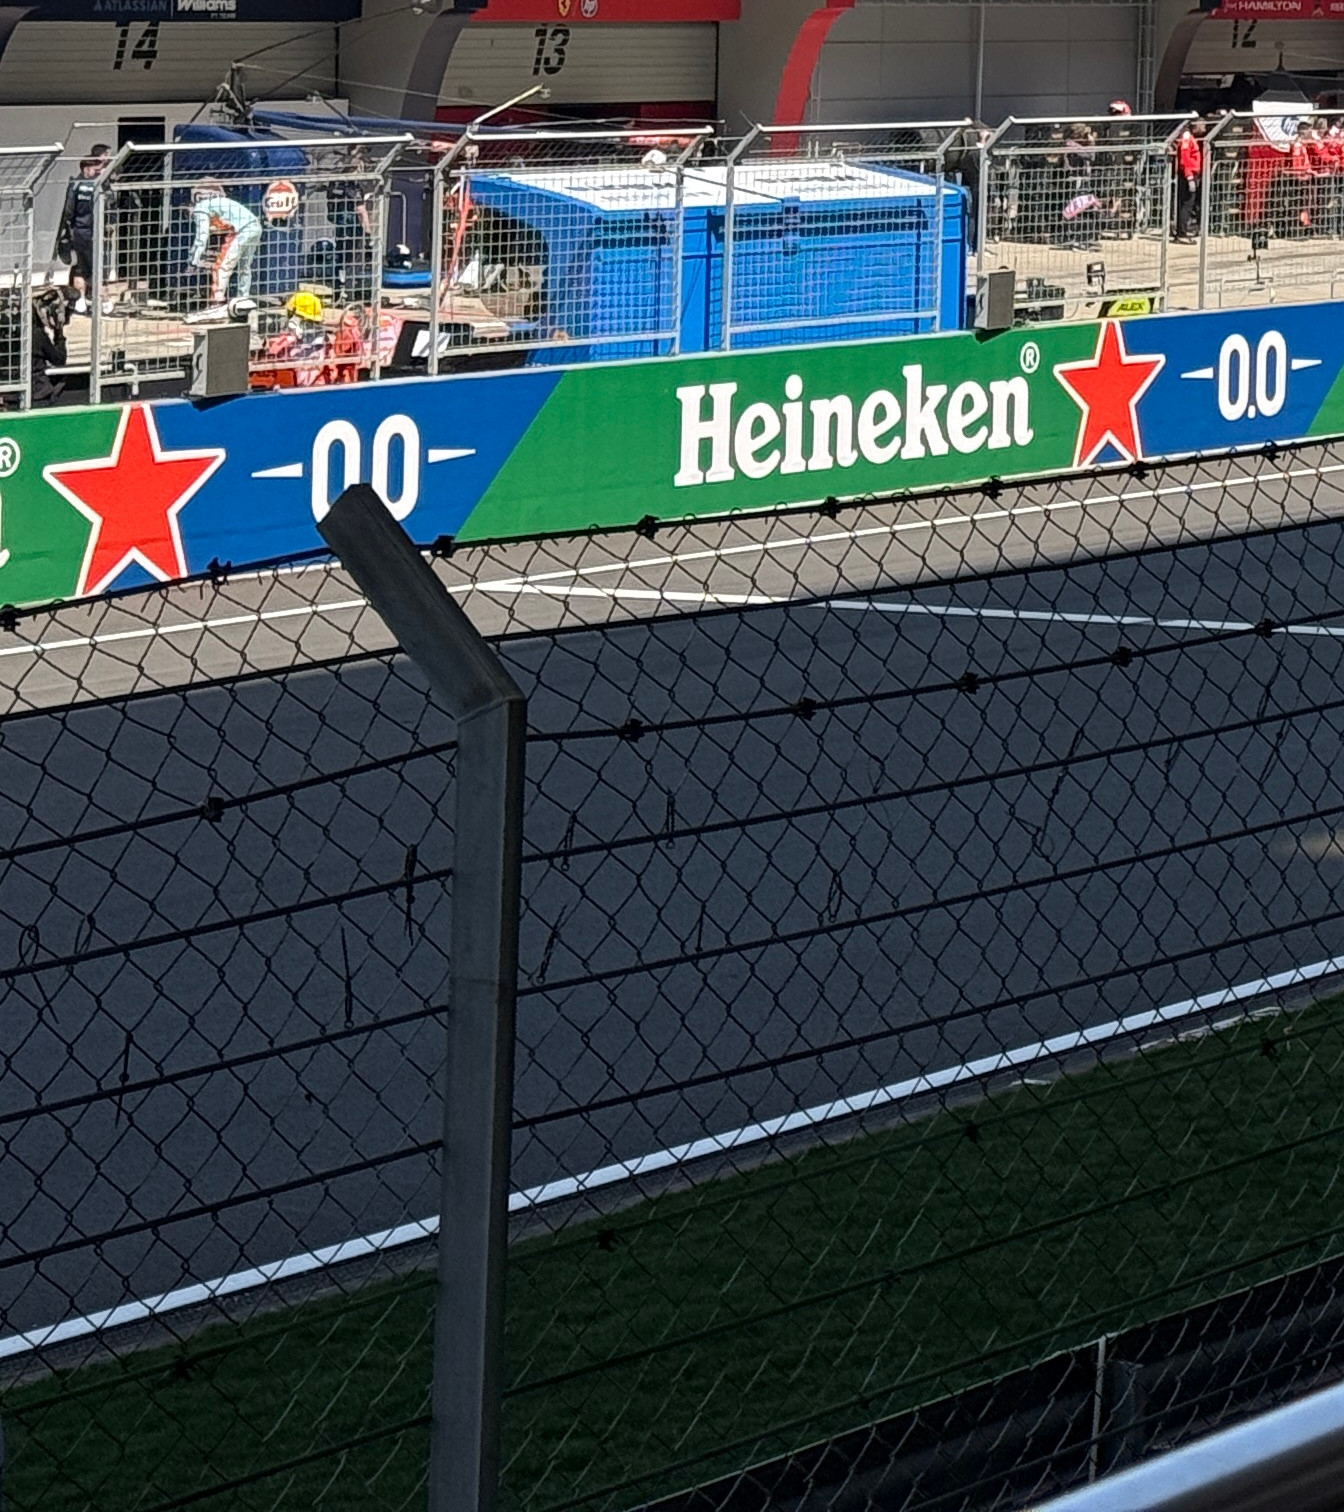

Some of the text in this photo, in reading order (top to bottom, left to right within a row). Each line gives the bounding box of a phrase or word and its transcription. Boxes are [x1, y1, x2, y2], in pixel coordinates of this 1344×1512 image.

[101, 0, 167, 12] ATLASSIAN
[1238, 0, 1302, 12] HAMILTON
[112, 21, 161, 71] 14
[531, 22, 571, 77] 13
[264, 196, 296, 209] Gulf
[1116, 301, 1146, 312] ALEX
[1218, 330, 1287, 421] 0.0
